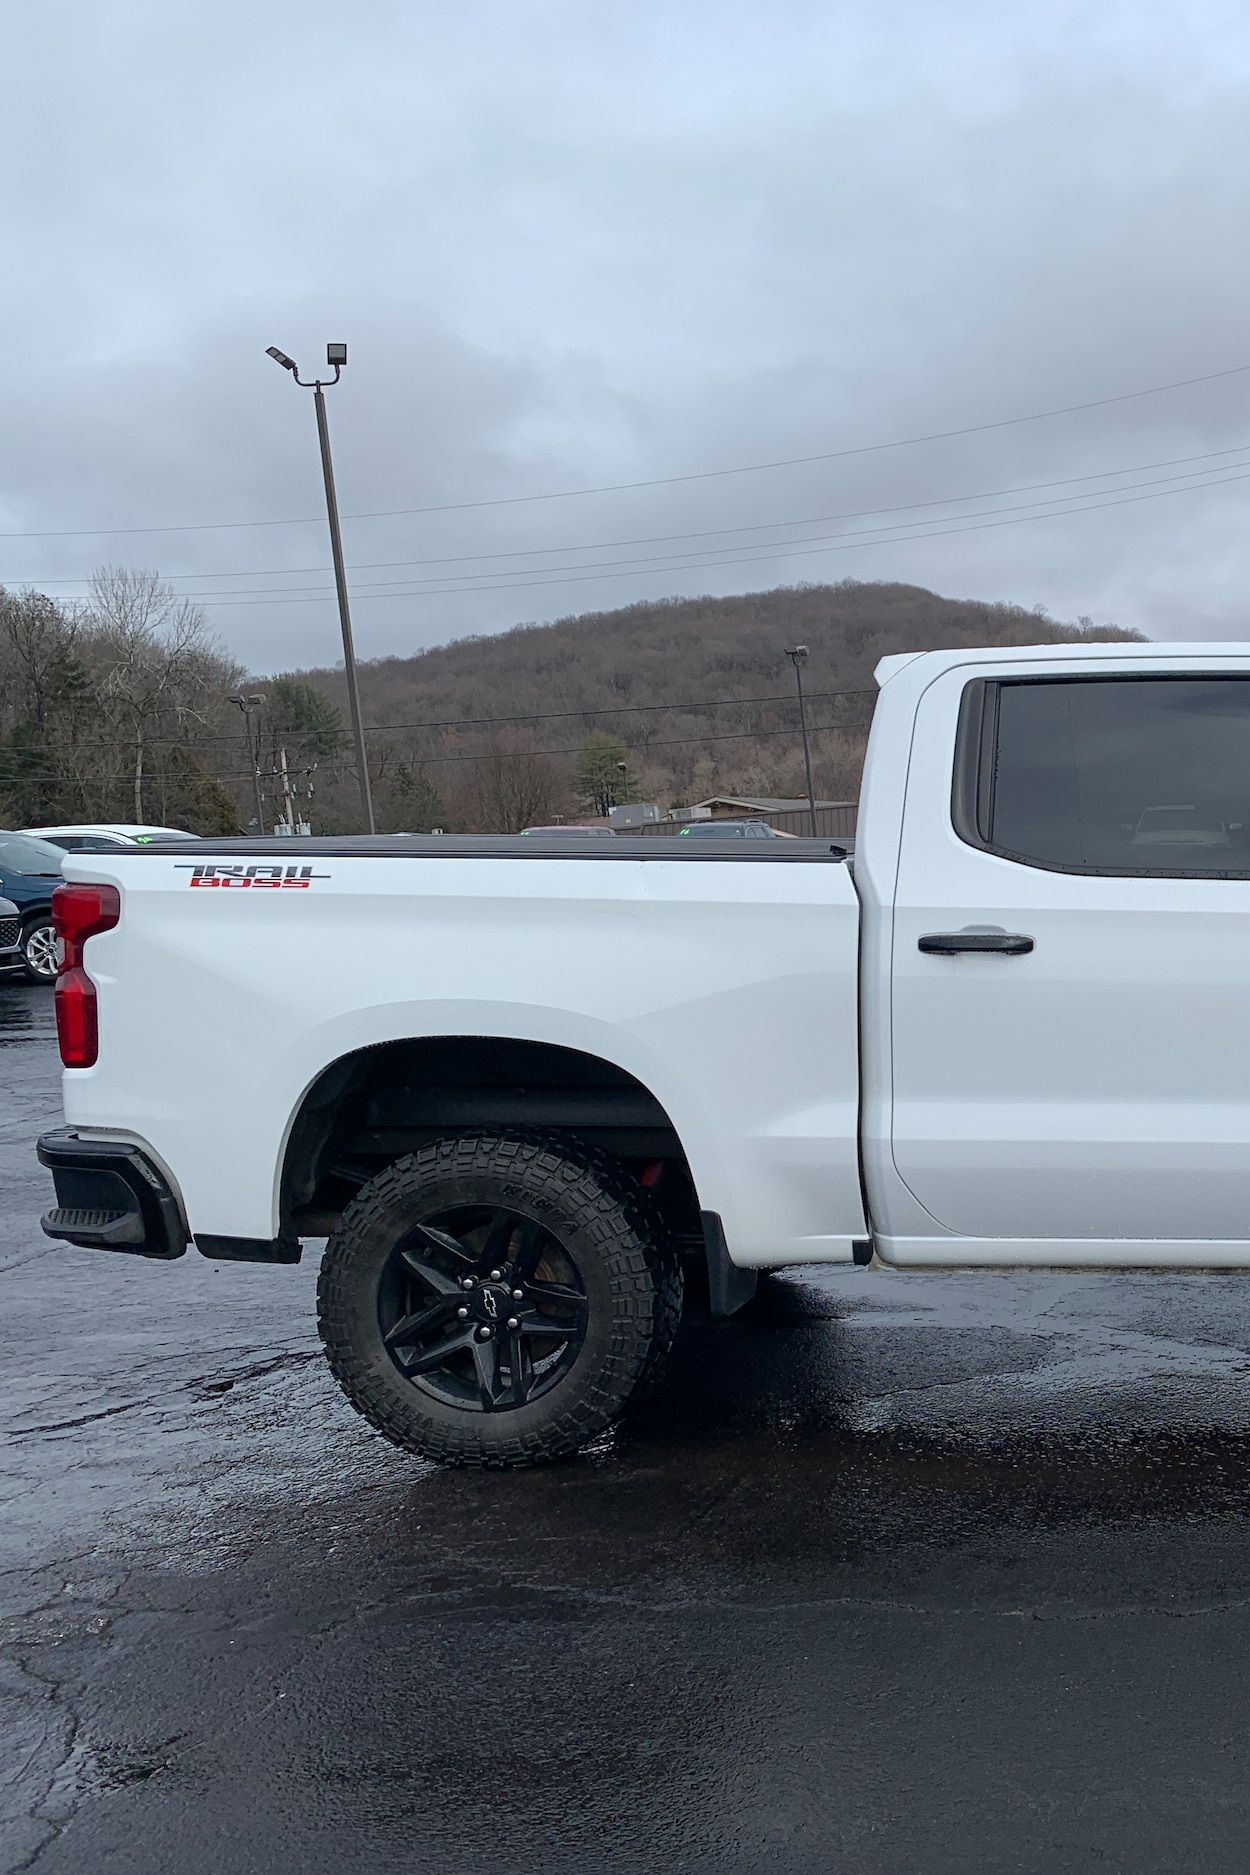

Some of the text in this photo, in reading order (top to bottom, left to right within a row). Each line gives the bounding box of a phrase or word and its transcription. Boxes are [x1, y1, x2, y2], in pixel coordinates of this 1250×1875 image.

[174, 864, 331, 878] TRAIL
[190, 877, 311, 889] BOSS
[502, 1183, 578, 1236] KENDA
